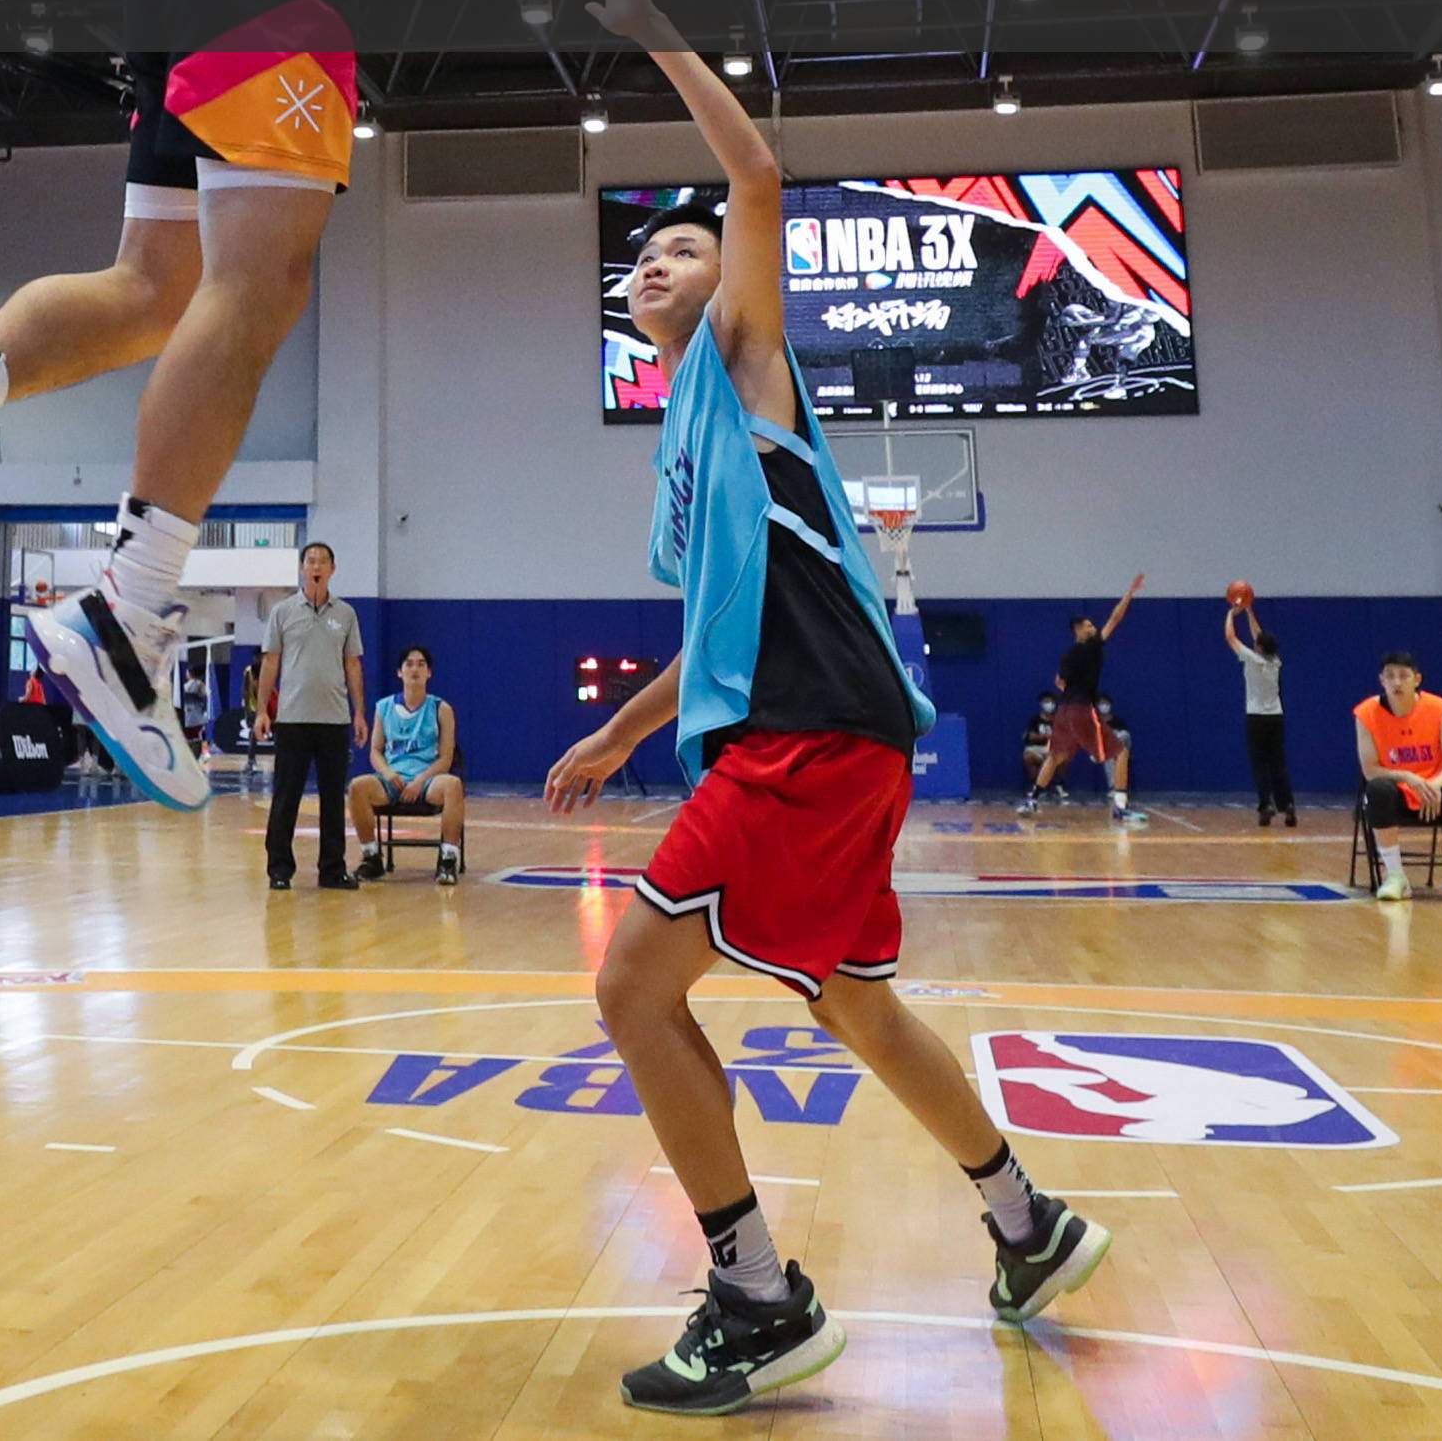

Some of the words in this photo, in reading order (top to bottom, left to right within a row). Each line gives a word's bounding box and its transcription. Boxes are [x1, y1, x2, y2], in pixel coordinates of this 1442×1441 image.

[825, 216, 915, 273] NBA
[918, 214, 979, 270] 3X
[11, 734, 49, 760] Wilson
[365, 1054, 863, 1125] NBA
